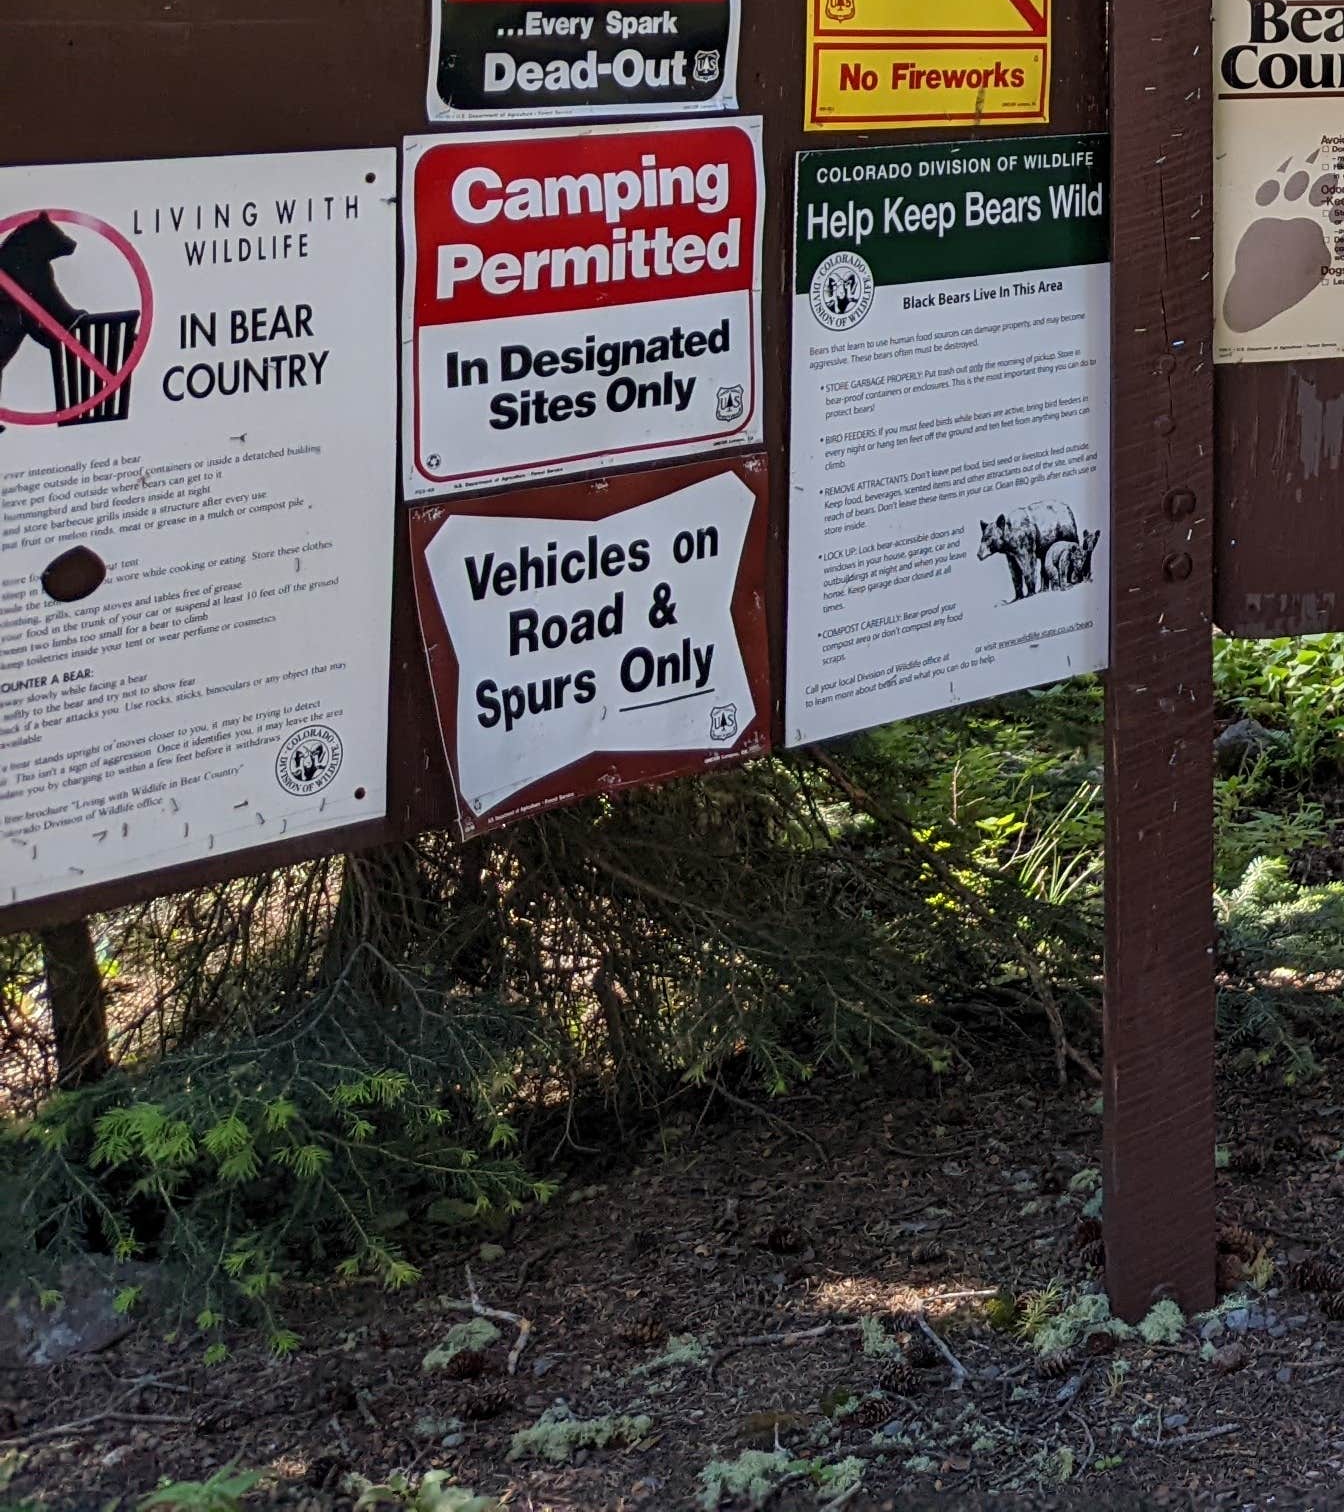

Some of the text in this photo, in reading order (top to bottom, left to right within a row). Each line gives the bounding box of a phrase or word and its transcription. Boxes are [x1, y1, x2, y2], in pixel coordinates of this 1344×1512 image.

[497, 10, 677, 39] ...Every Spark
[484, 50, 687, 93] Dead-Out
[840, 62, 1024, 91] No Fireworks
[451, 155, 729, 224] Camping
[816, 151, 1094, 183] COLORADO DIVISION OF WILDLIFE
[134, 195, 358, 234] LIVING WITH
[807, 183, 1103, 245] Help Keep Bears Wild
[185, 234, 308, 266] WILDLIFE
[437, 218, 741, 300] Permitted
[903, 280, 1063, 309] Black Bears Live In This Area
[180, 304, 314, 349] IN BEAR
[163, 351, 329, 401] COUNTRY
[447, 319, 729, 388] In Designated
[489, 371, 696, 430] Sites Only
[91, 458, 110, 469] feed
[122, 455, 141, 464] bear
[464, 525, 718, 601] Vehicles on
[509, 582, 678, 656] Road &
[476, 638, 714, 732] Spurs Only
